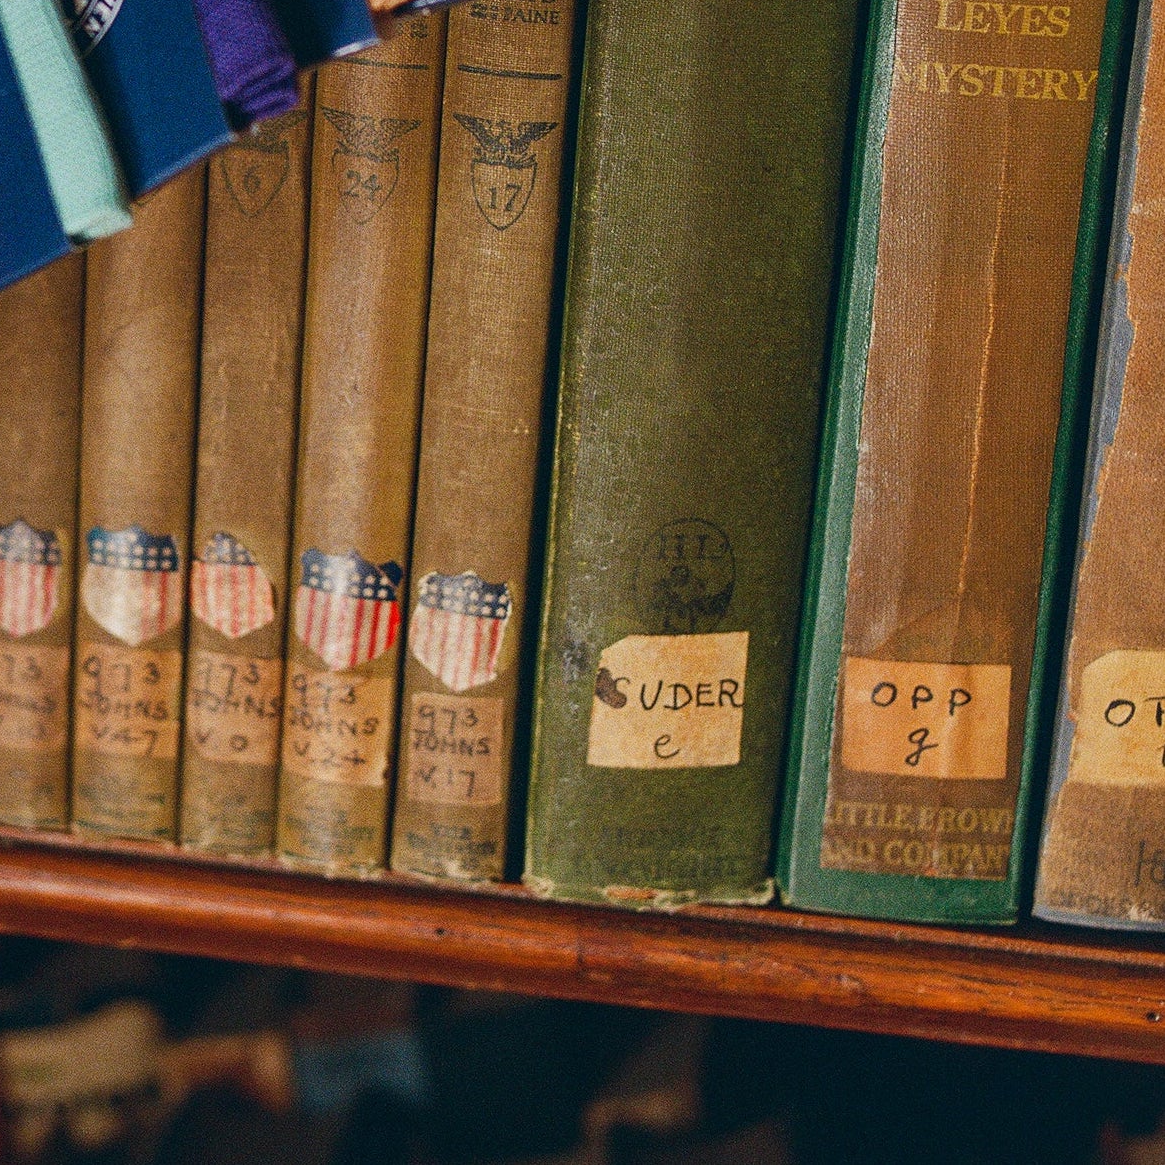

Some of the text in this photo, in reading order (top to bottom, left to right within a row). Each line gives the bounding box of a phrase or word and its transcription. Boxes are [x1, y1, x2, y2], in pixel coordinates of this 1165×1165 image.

[502, 6, 561, 25] PAINE
[893, 56, 1098, 102] MYSTERY
[243, 165, 262, 195] 6
[342, 168, 383, 201] 24
[487, 183, 523, 213] 17
[611, 675, 745, 711] SUDER
[869, 680, 972, 716] OPP
[416, 704, 480, 734] 973
[412, 729, 493, 756] JOHNS
[653, 733, 681, 759] e
[904, 727, 940, 766] g
